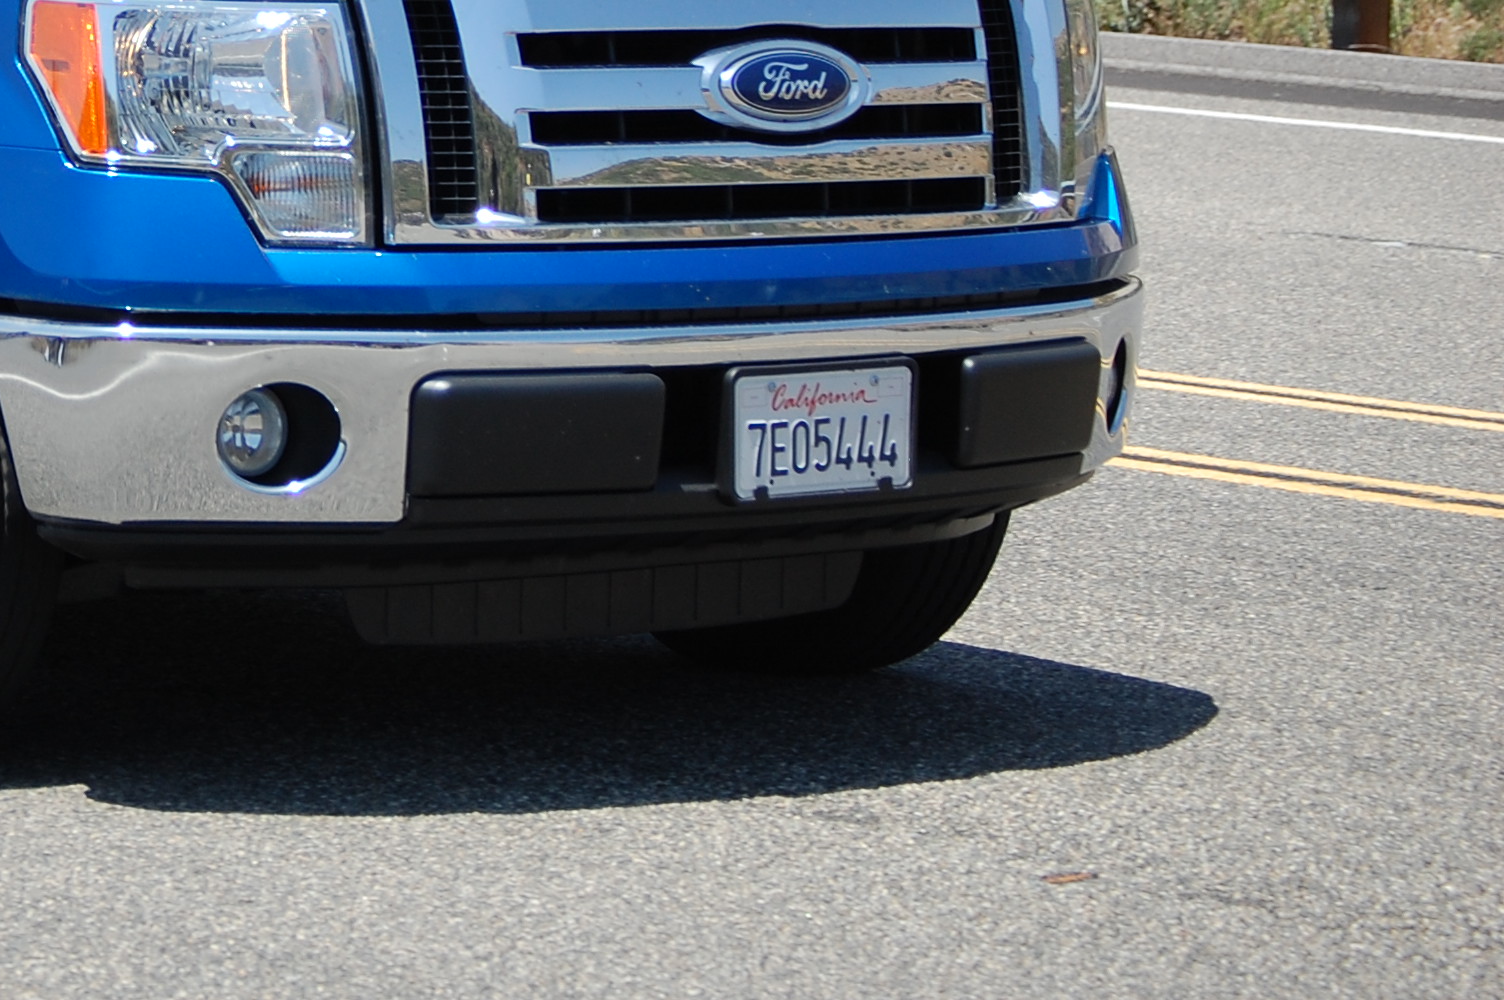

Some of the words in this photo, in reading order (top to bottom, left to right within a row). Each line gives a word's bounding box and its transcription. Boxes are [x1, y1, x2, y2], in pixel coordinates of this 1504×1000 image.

[758, 61, 827, 100] Ford
[771, 382, 877, 416] California
[748, 413, 897, 478] 7E05444
